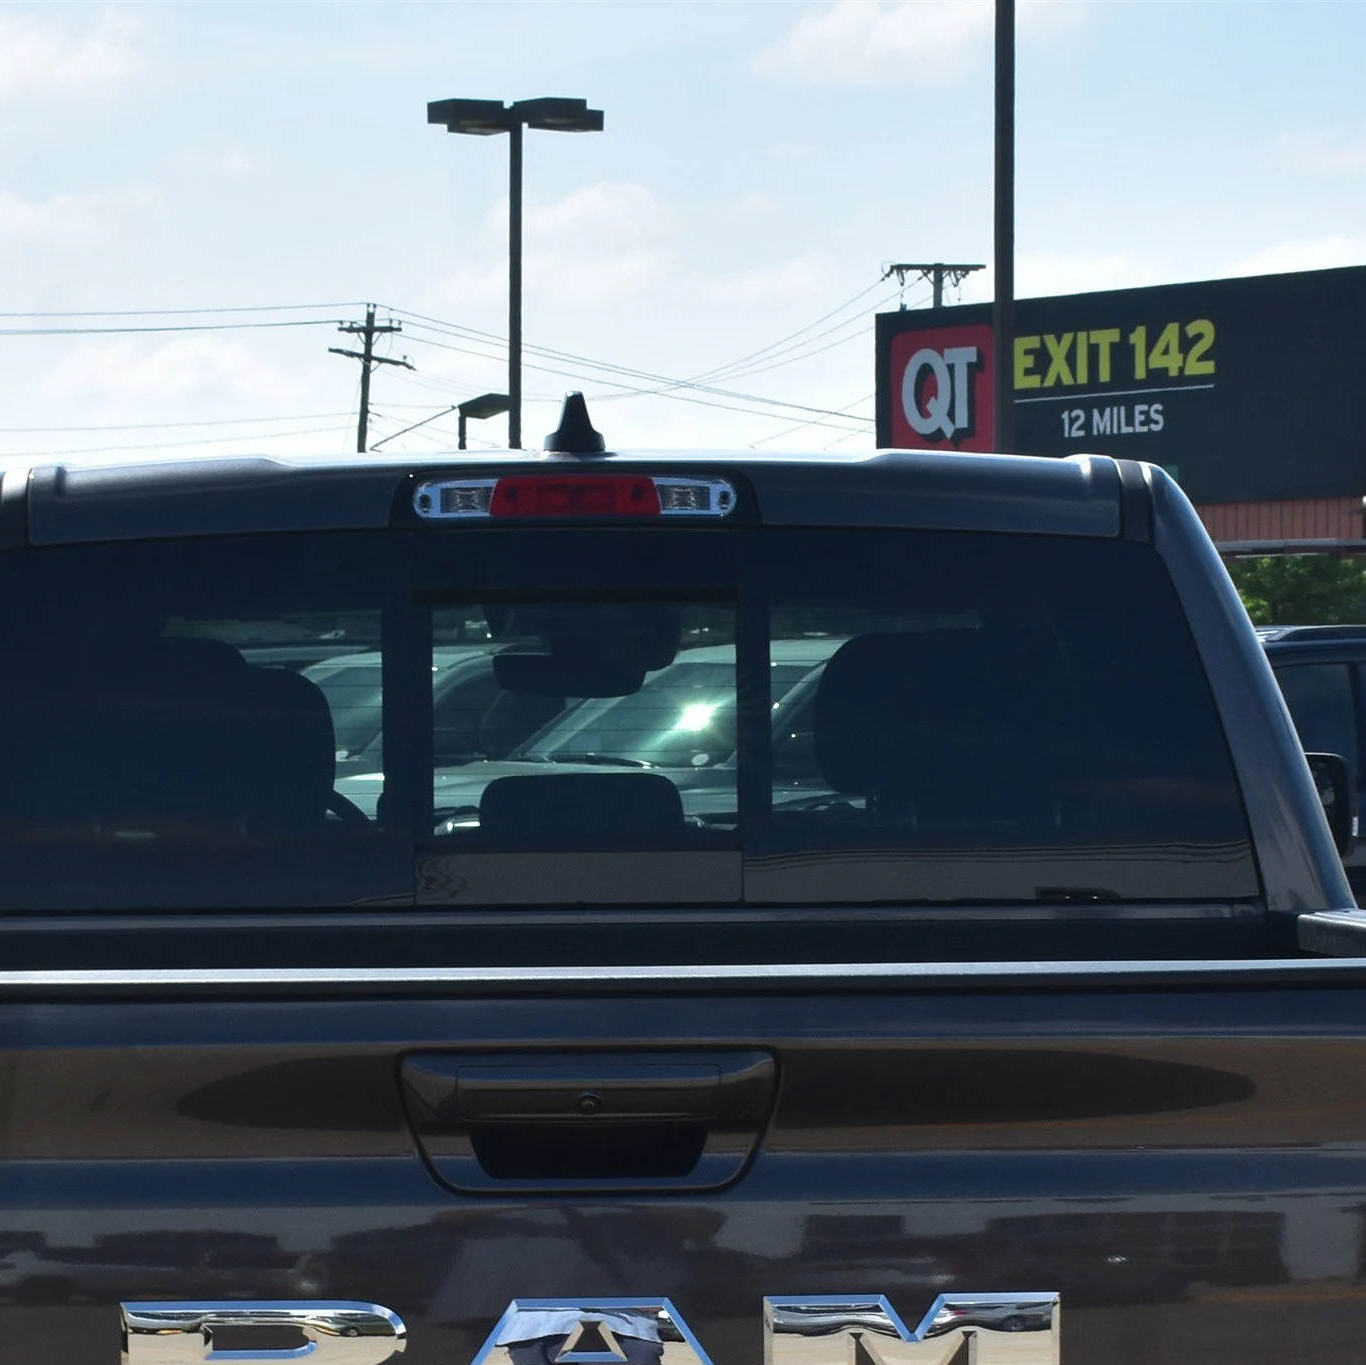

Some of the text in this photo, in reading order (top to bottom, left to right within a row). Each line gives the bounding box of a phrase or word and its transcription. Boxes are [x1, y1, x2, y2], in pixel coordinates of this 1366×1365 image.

[1013, 319, 1216, 390] EXIT 142
[902, 346, 977, 439] QT
[1061, 403, 1165, 438] 12 MILES
